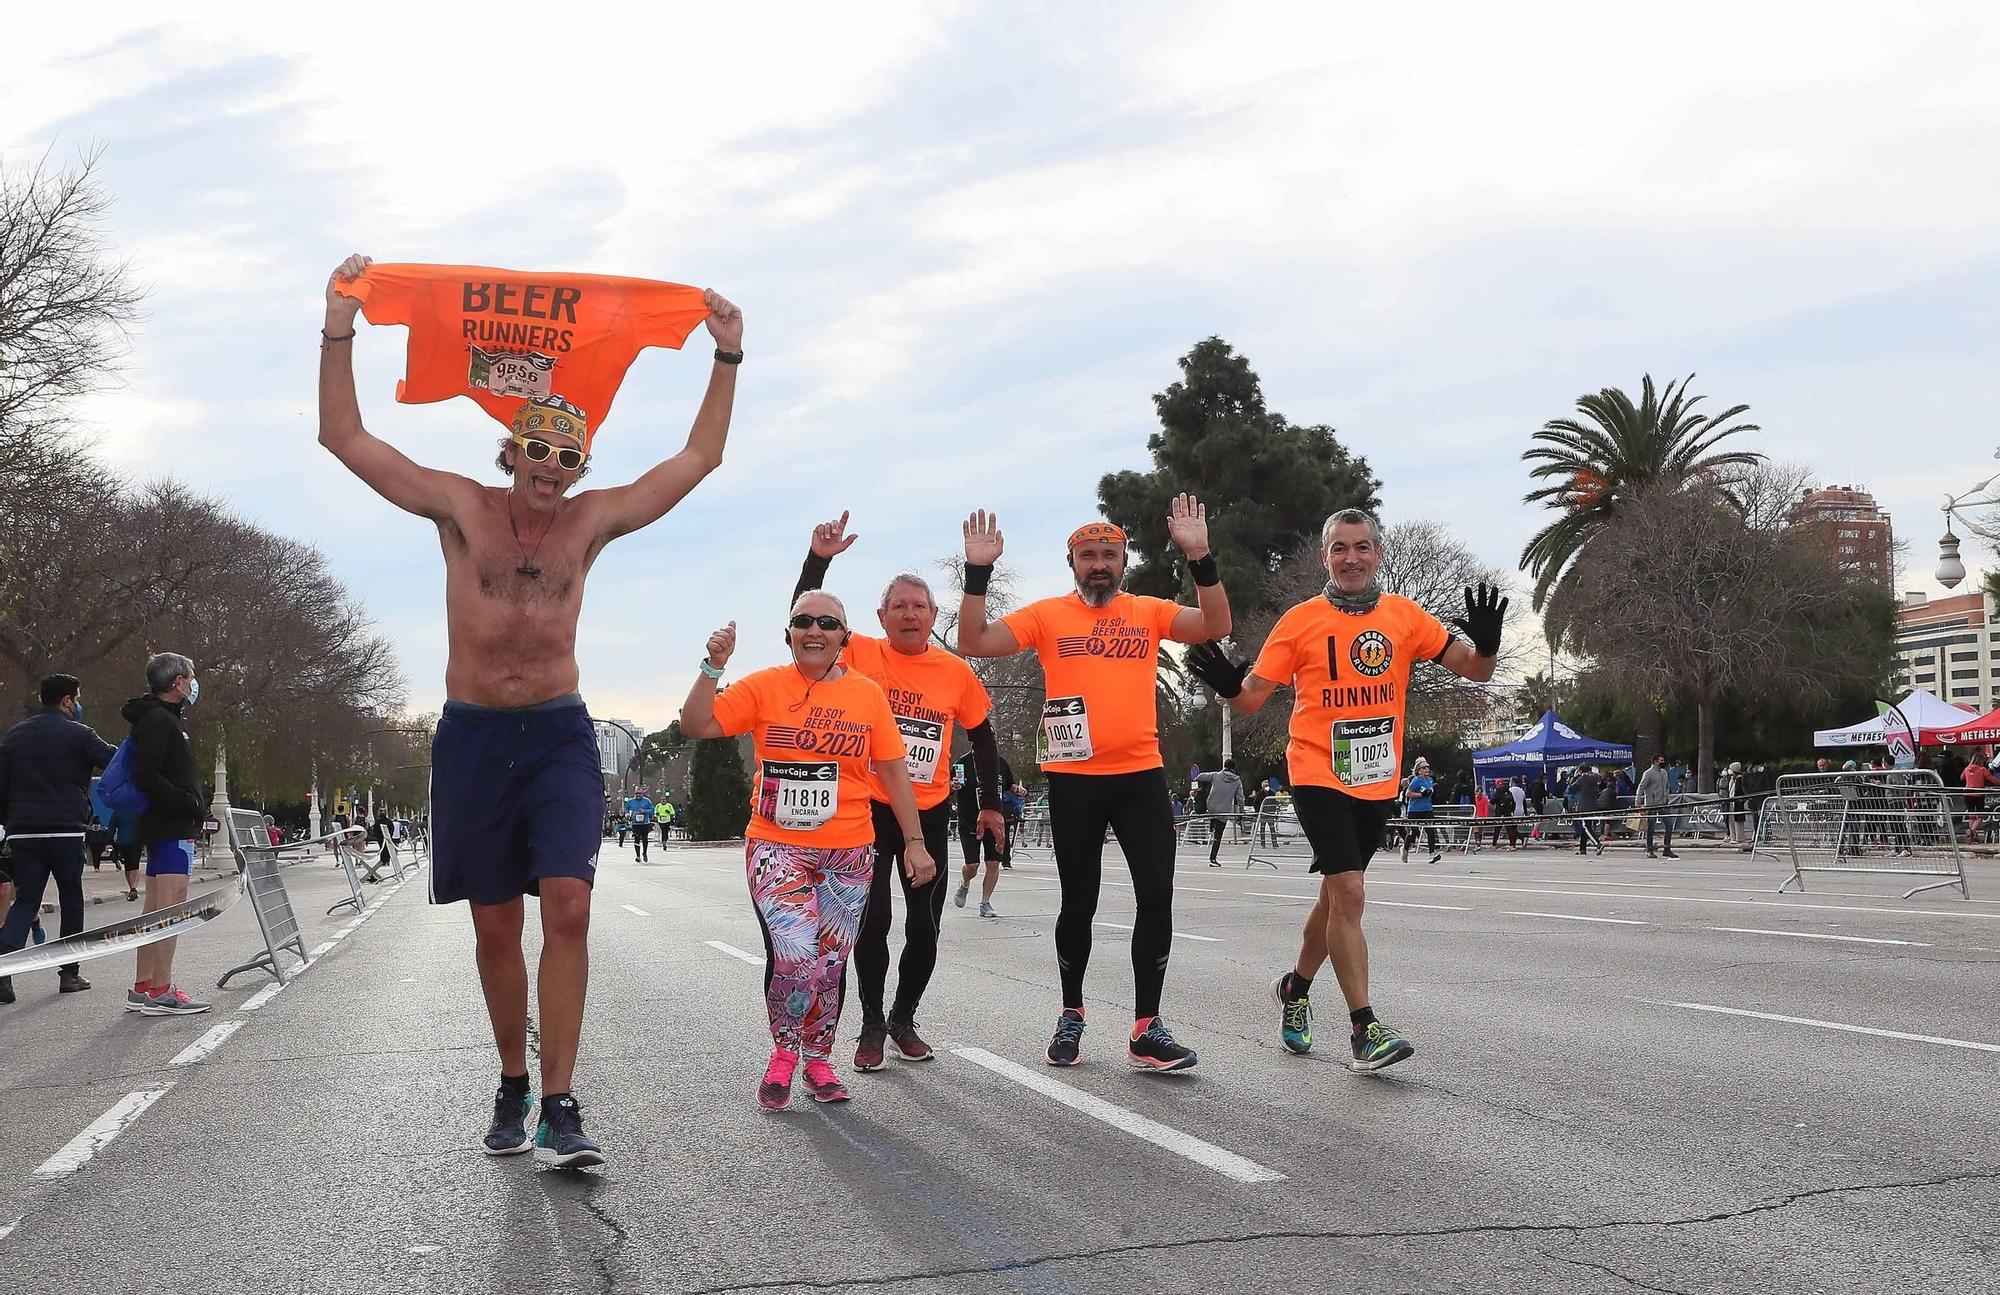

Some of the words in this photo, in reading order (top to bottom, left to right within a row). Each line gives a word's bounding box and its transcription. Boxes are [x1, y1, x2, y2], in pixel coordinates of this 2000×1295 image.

[463, 281, 582, 324] BEER
[462, 319, 574, 351] RUNNERS
[1096, 618, 1108, 627] YO
[1109, 617, 1126, 628] SOY
[1092, 626, 1116, 637] BEER
[1358, 632, 1384, 643] BEER
[1103, 638, 1149, 659] 2020
[1327, 635, 1338, 681] I
[1353, 656, 1391, 675] RUNNERS
[888, 688, 900, 701] YO
[902, 690, 923, 705] SOY
[1322, 682, 1394, 708] RUNNING
[810, 706, 822, 717] YO
[824, 708, 845, 720] SOY
[804, 717, 831, 731] BEER
[833, 720, 873, 734] RUNNER
[1048, 723, 1083, 741] 10012
[1340, 725, 1376, 735] iberCaja
[814, 732, 866, 758] 2020
[1354, 742, 1388, 764] 10073
[1594, 750, 1612, 759] Paco
[769, 765, 808, 778] iberCaja
[783, 787, 830, 808] 11818
[791, 808, 819, 817] ENCARNA
